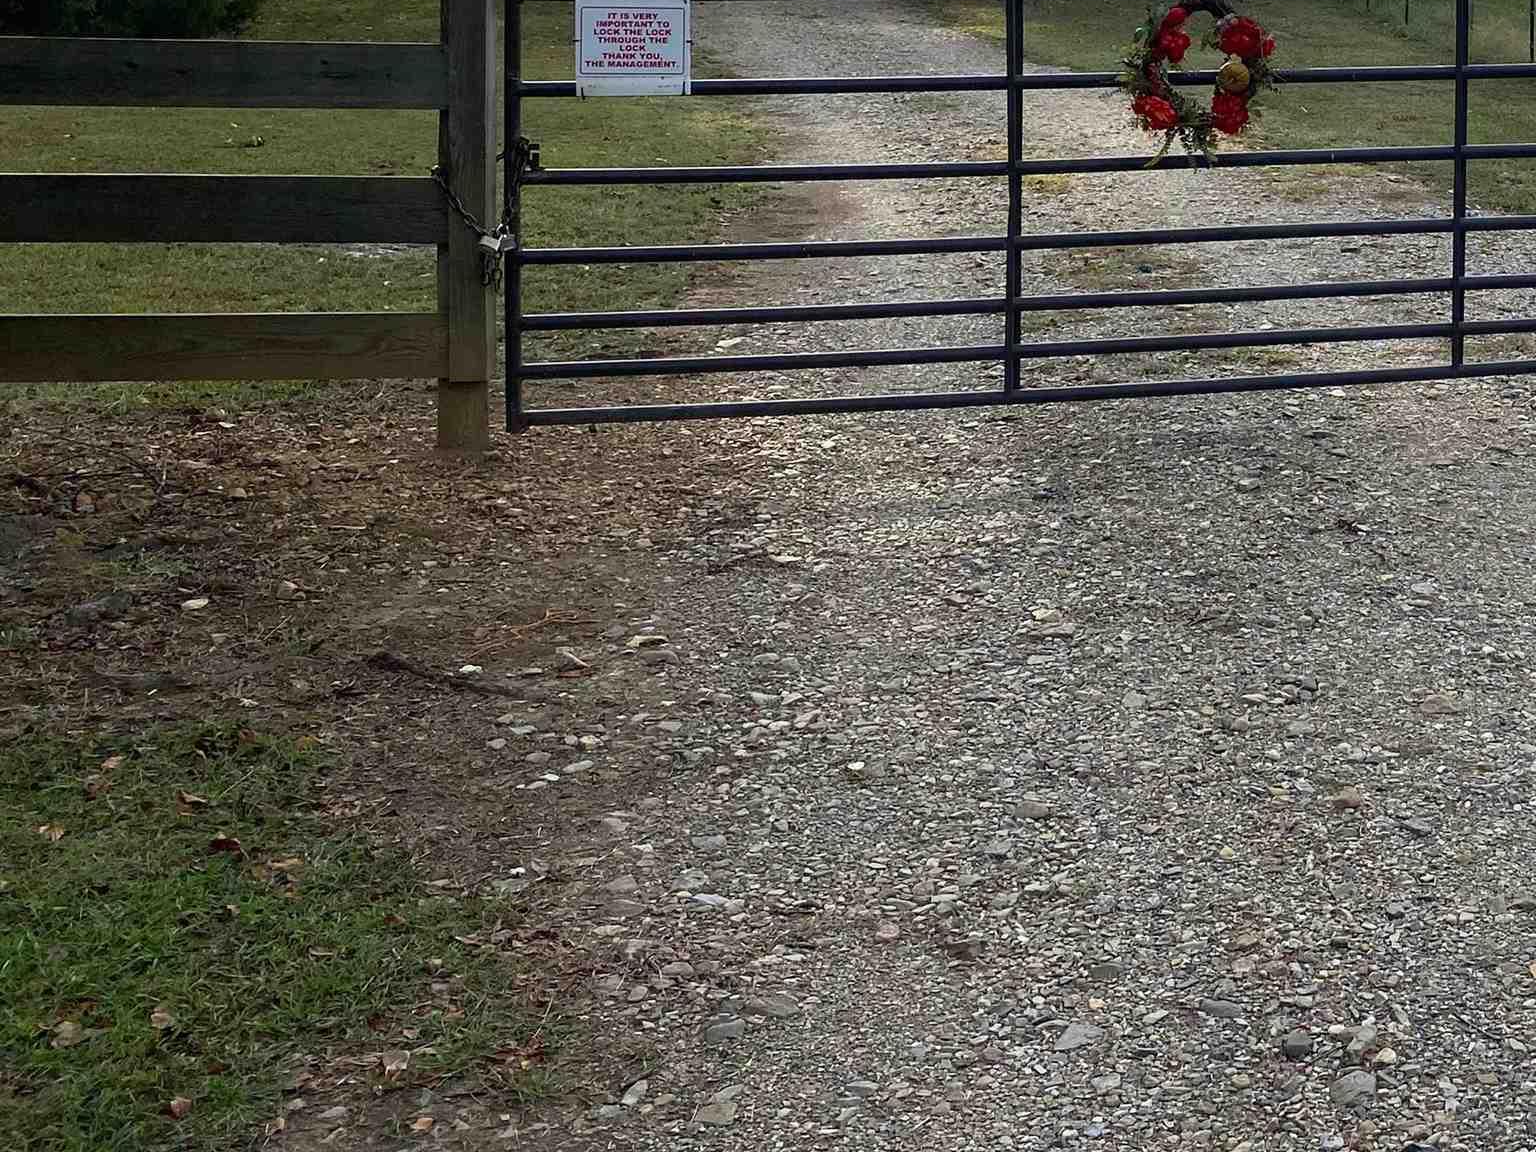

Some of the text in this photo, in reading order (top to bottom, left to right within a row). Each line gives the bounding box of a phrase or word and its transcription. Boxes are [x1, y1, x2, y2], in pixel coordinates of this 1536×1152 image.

[607, 12, 658, 20] IT IS VERY
[596, 20, 670, 28] IMPORTANT TO
[593, 28, 672, 36] LOCK THE LOCK
[598, 36, 668, 44] THROUGH THE
[619, 44, 646, 52] LOCK
[602, 52, 637, 60] THANK
[585, 60, 605, 68] THE
